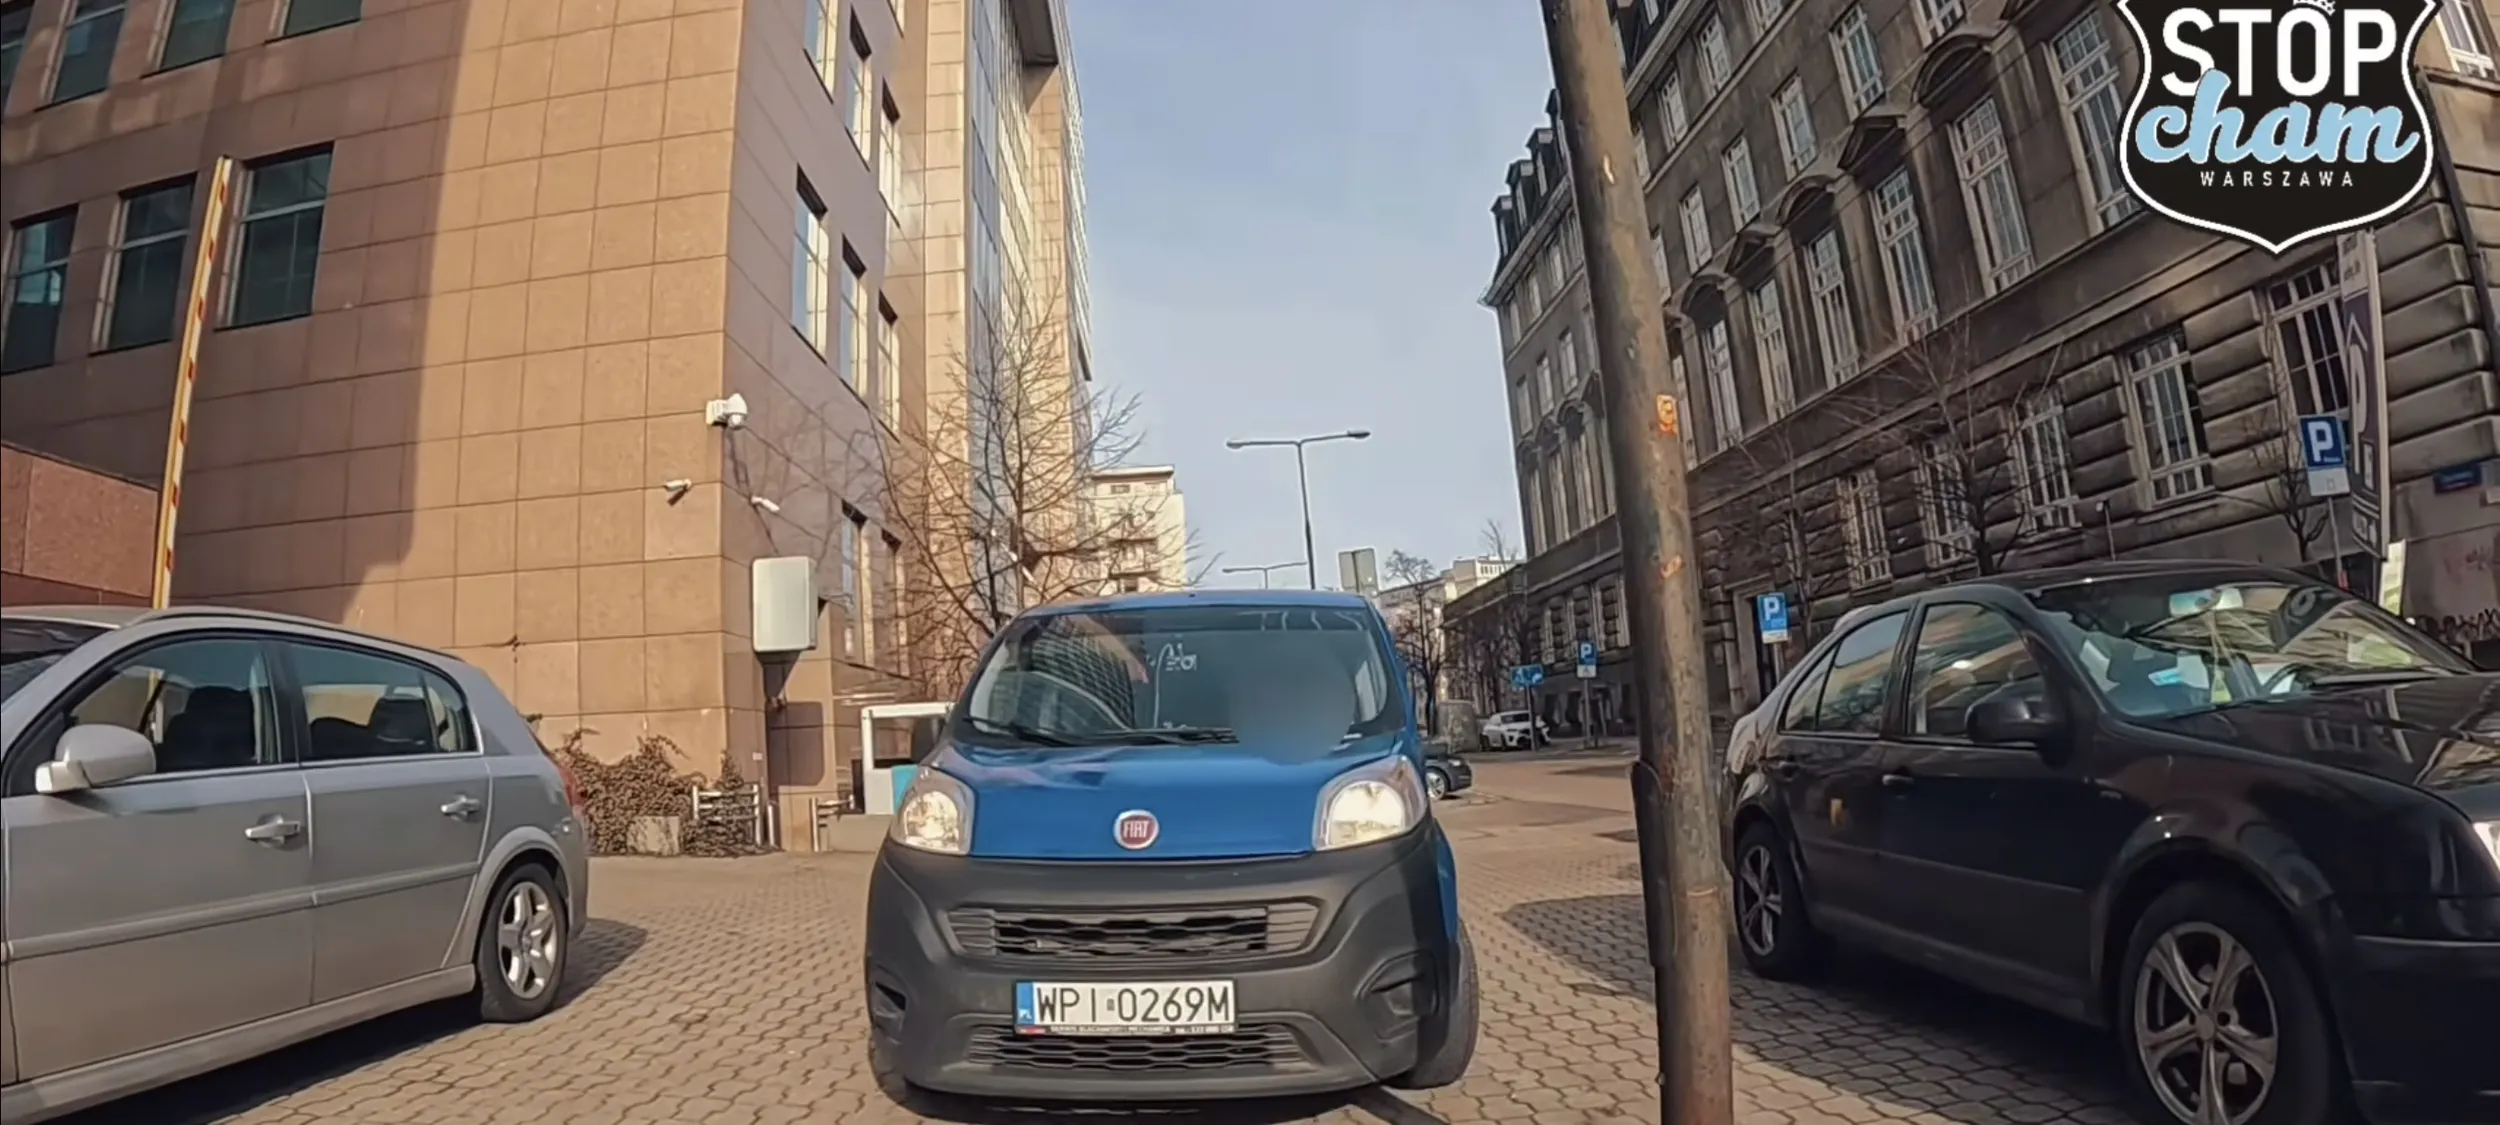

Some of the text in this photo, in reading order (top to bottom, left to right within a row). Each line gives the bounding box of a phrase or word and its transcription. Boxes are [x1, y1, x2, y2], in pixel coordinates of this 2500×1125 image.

[2308, 421, 2334, 462] P
[1763, 596, 1780, 621] P
[1580, 643, 1592, 659] P
[1123, 820, 1149, 839] FIAT
[1037, 986, 1229, 1022] WPI 0269M
